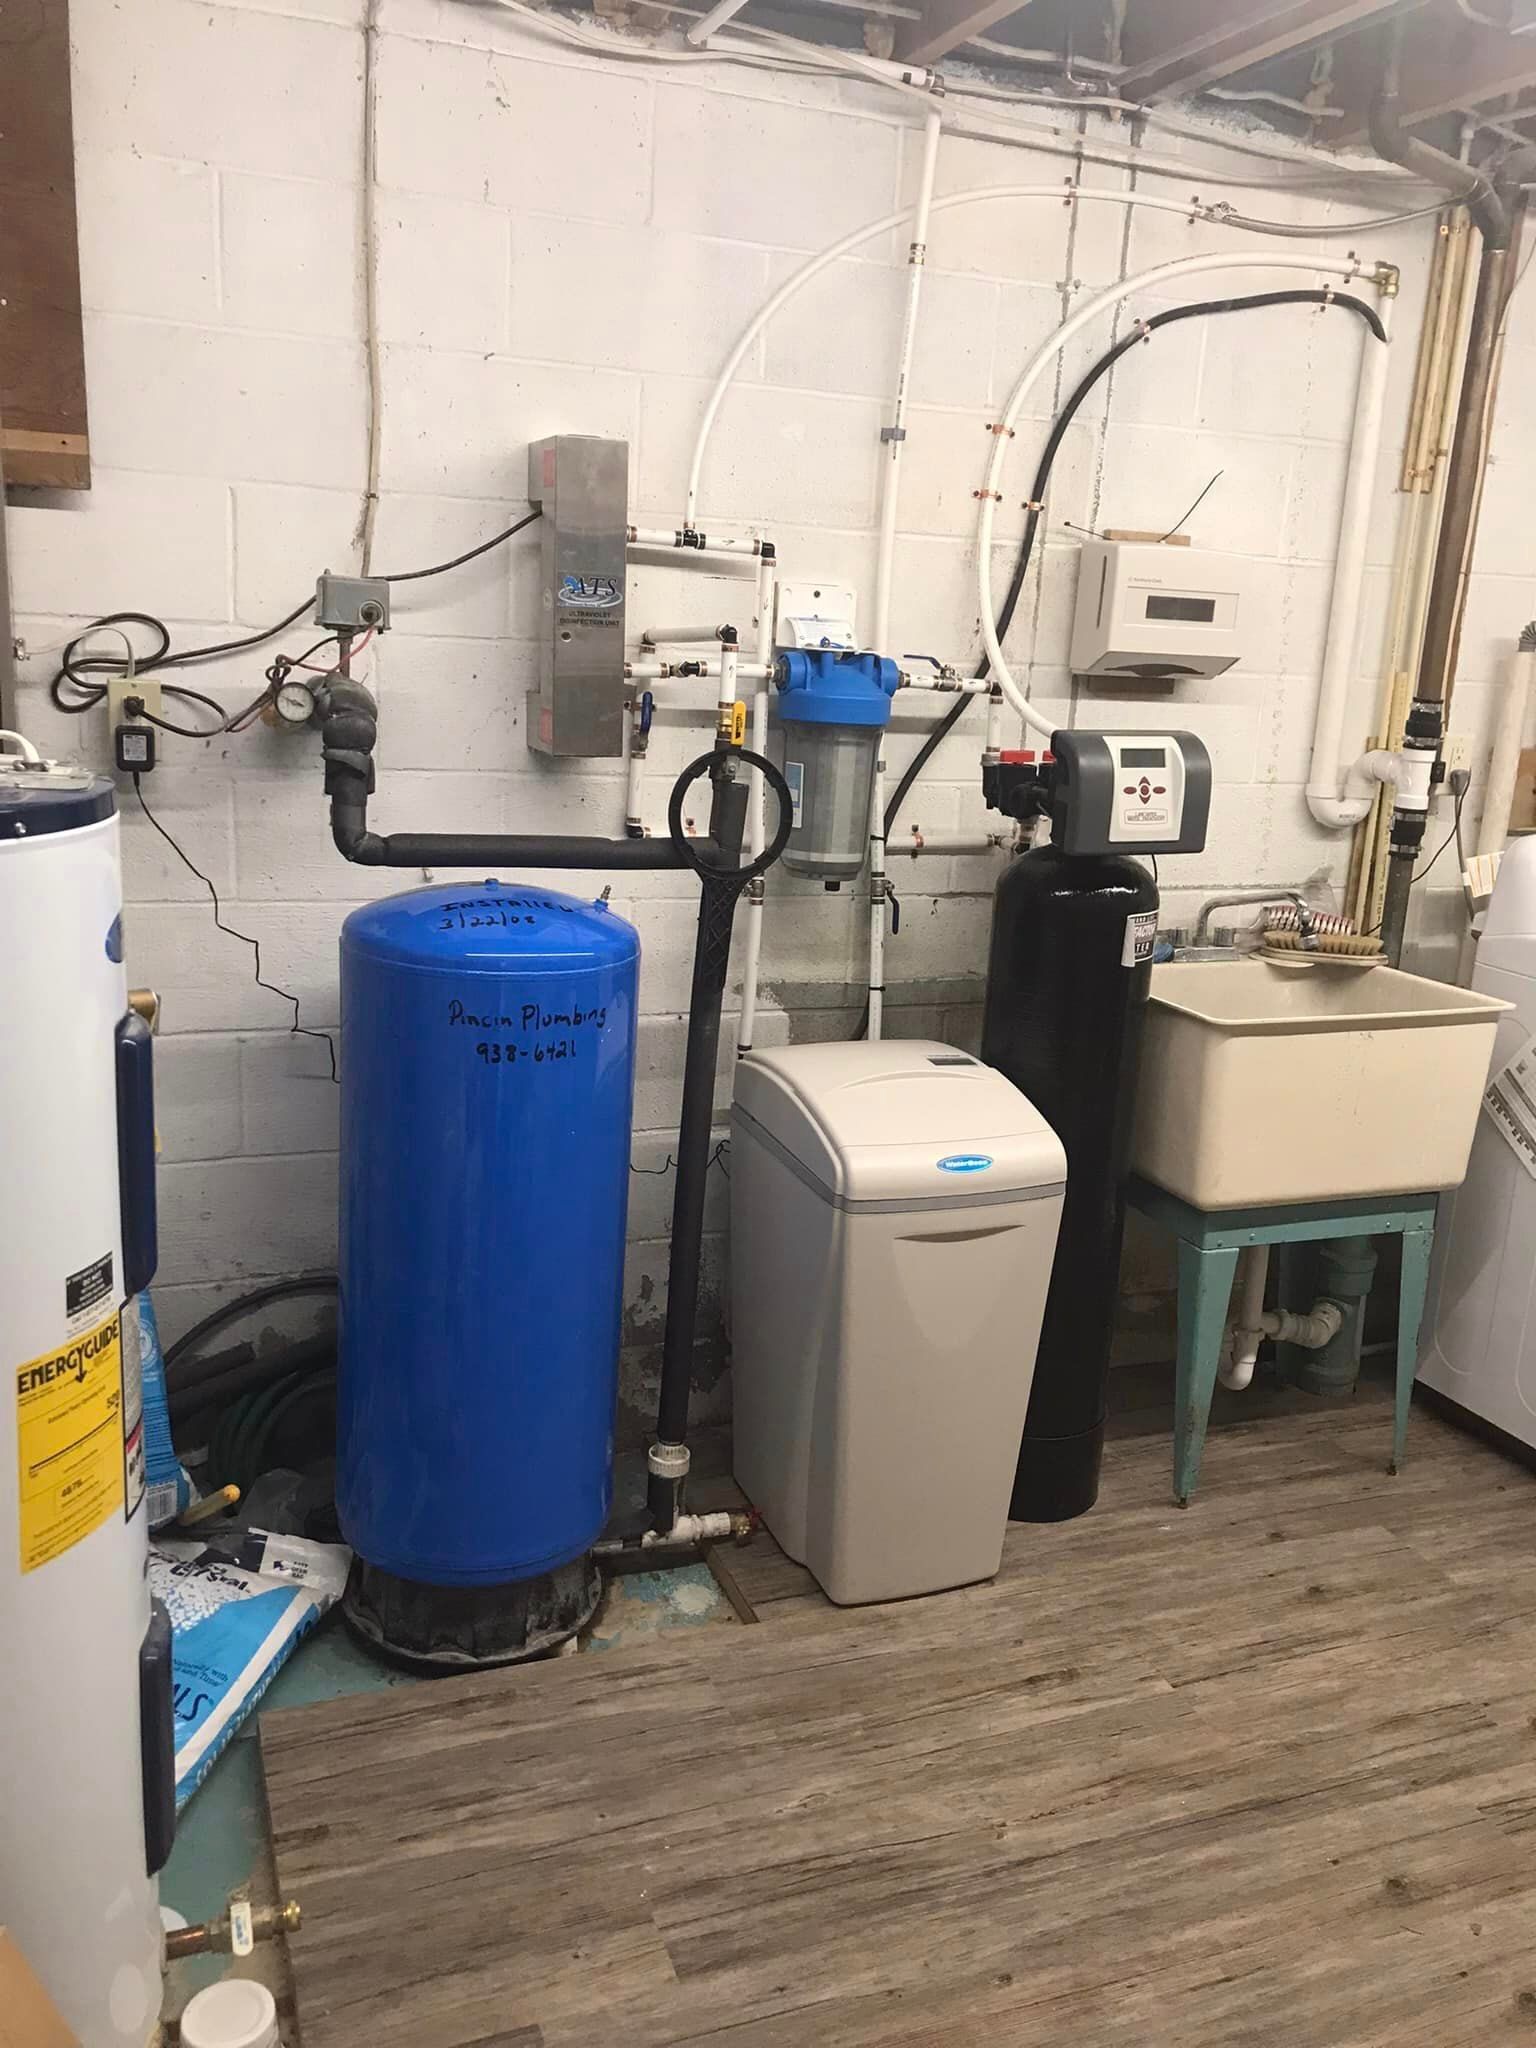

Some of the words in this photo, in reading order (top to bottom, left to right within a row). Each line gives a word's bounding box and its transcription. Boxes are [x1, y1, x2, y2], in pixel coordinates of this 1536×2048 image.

[569, 577, 617, 595] ATS
[521, 1003, 606, 1031] Plumbing
[476, 1039, 577, 1064] 938-6421
[18, 1320, 119, 1395] ENERGYGUIDE
